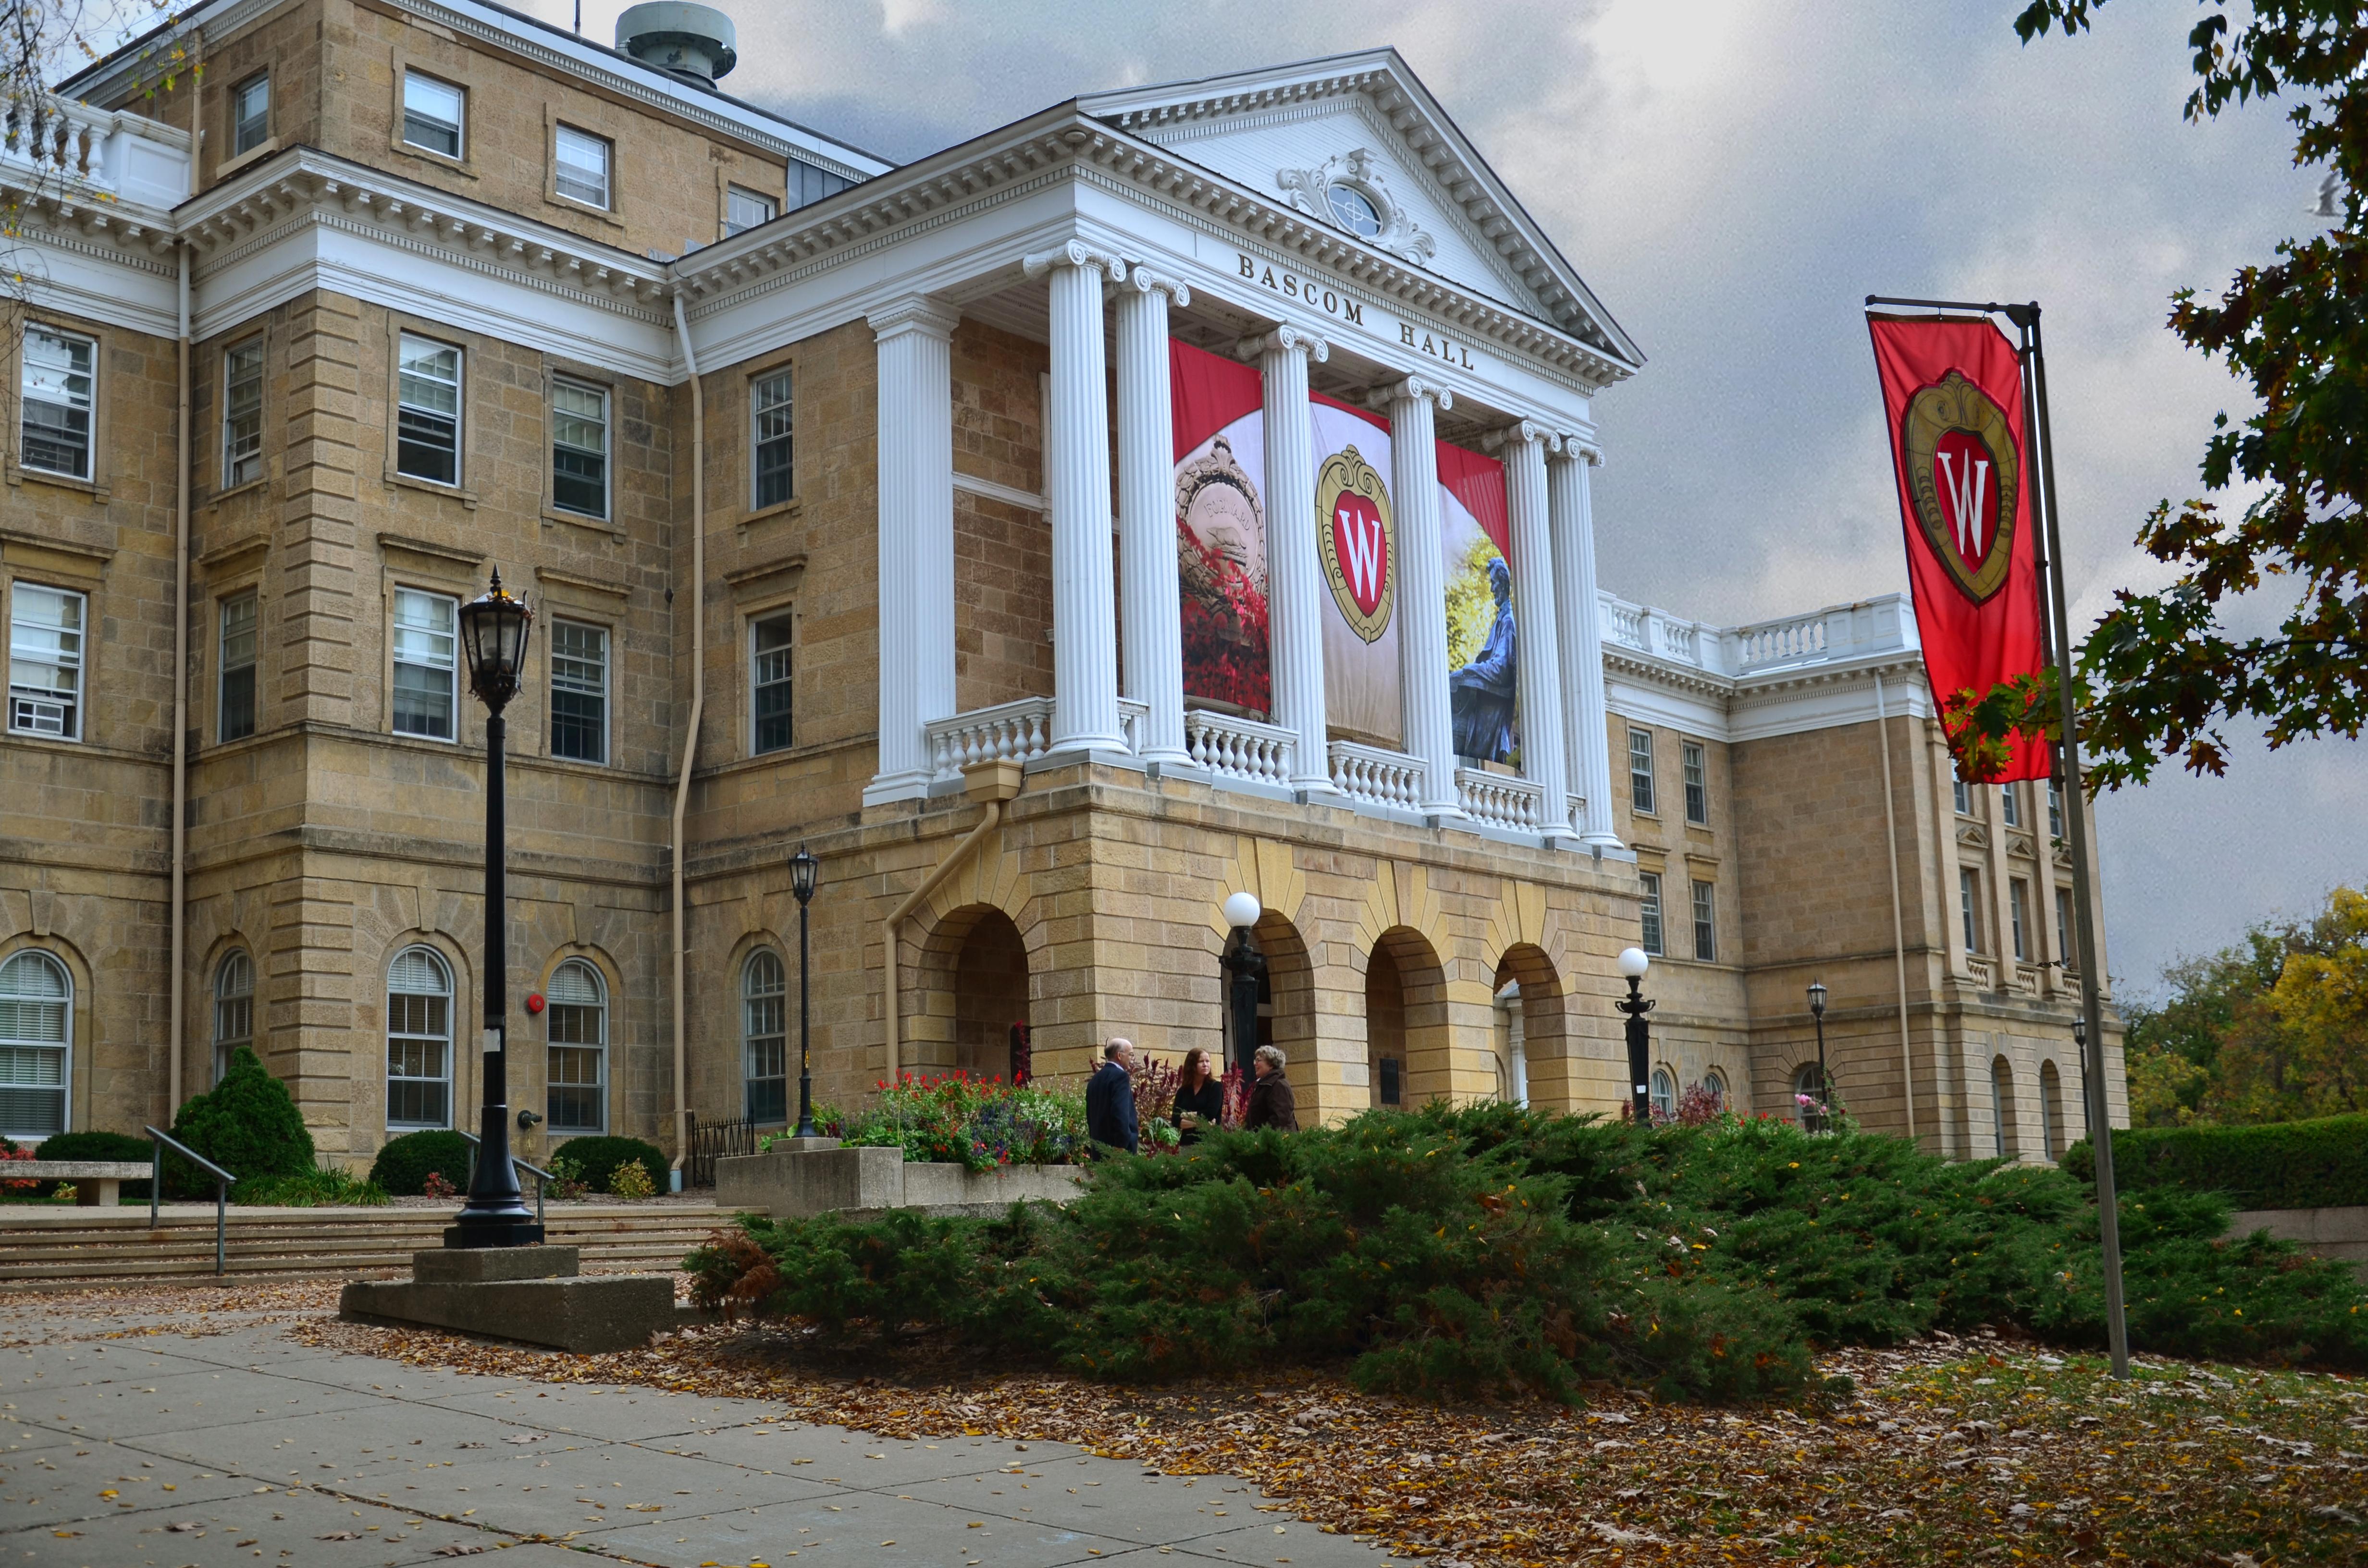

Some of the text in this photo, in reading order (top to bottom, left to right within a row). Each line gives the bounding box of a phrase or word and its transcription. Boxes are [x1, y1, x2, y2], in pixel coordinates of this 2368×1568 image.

[1237, 253, 1474, 370] BASCOM HALL
[1203, 499, 1250, 531] FORWARD
[1937, 448, 1988, 557] W
[1339, 509, 1380, 602] W
